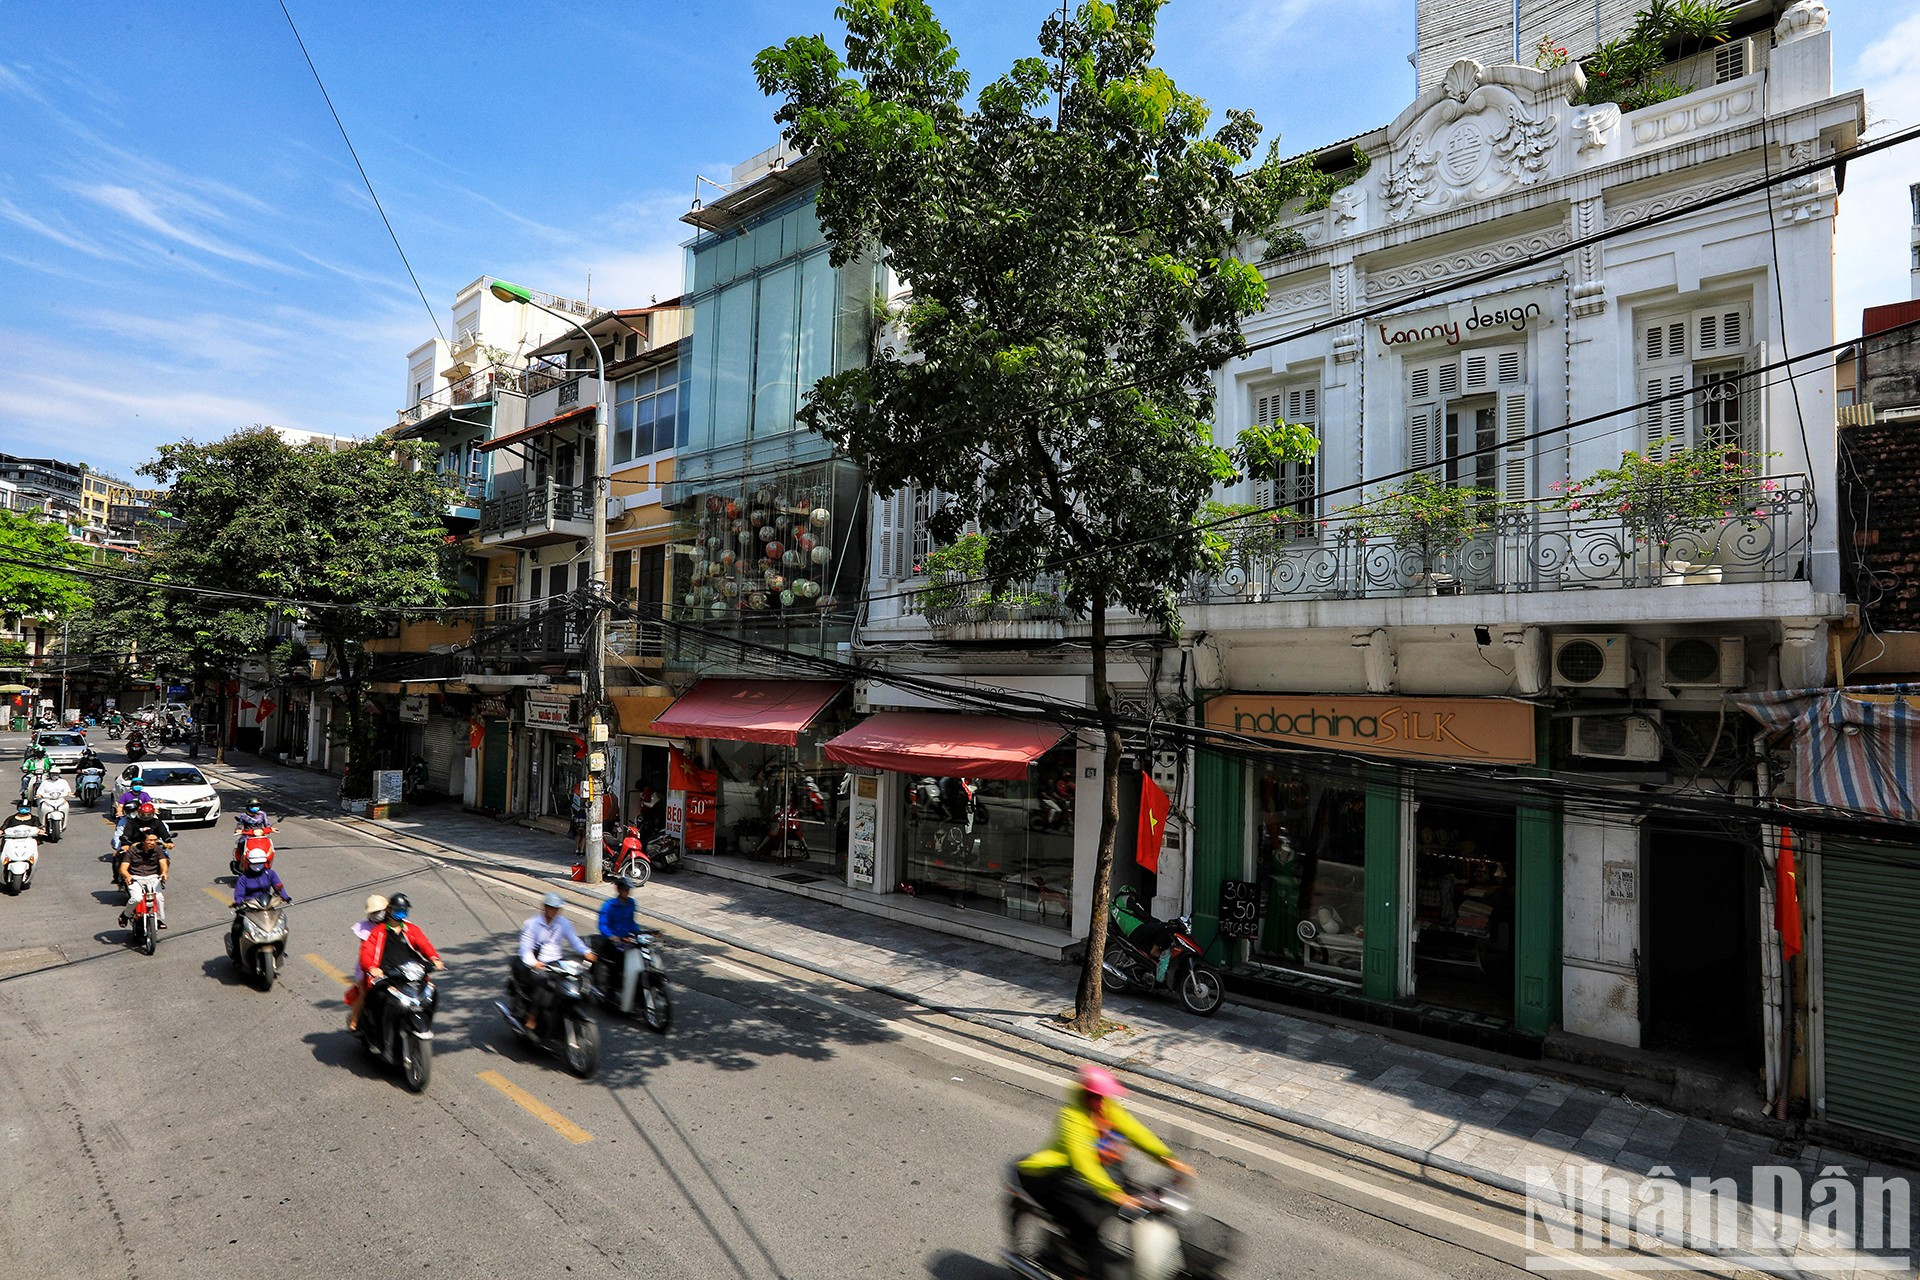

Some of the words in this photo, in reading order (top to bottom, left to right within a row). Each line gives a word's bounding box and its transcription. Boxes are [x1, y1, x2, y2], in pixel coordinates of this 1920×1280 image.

[1379, 321, 1460, 346] tanmy
[1465, 305, 1540, 332] design
[109, 487, 136, 499] MAY
[1234, 706, 1378, 739] indochina
[666, 803, 682, 822] BÉO
[690, 799, 704, 815] 50
[673, 824, 681, 833] SIZE
[1233, 900, 1256, 920] 50
